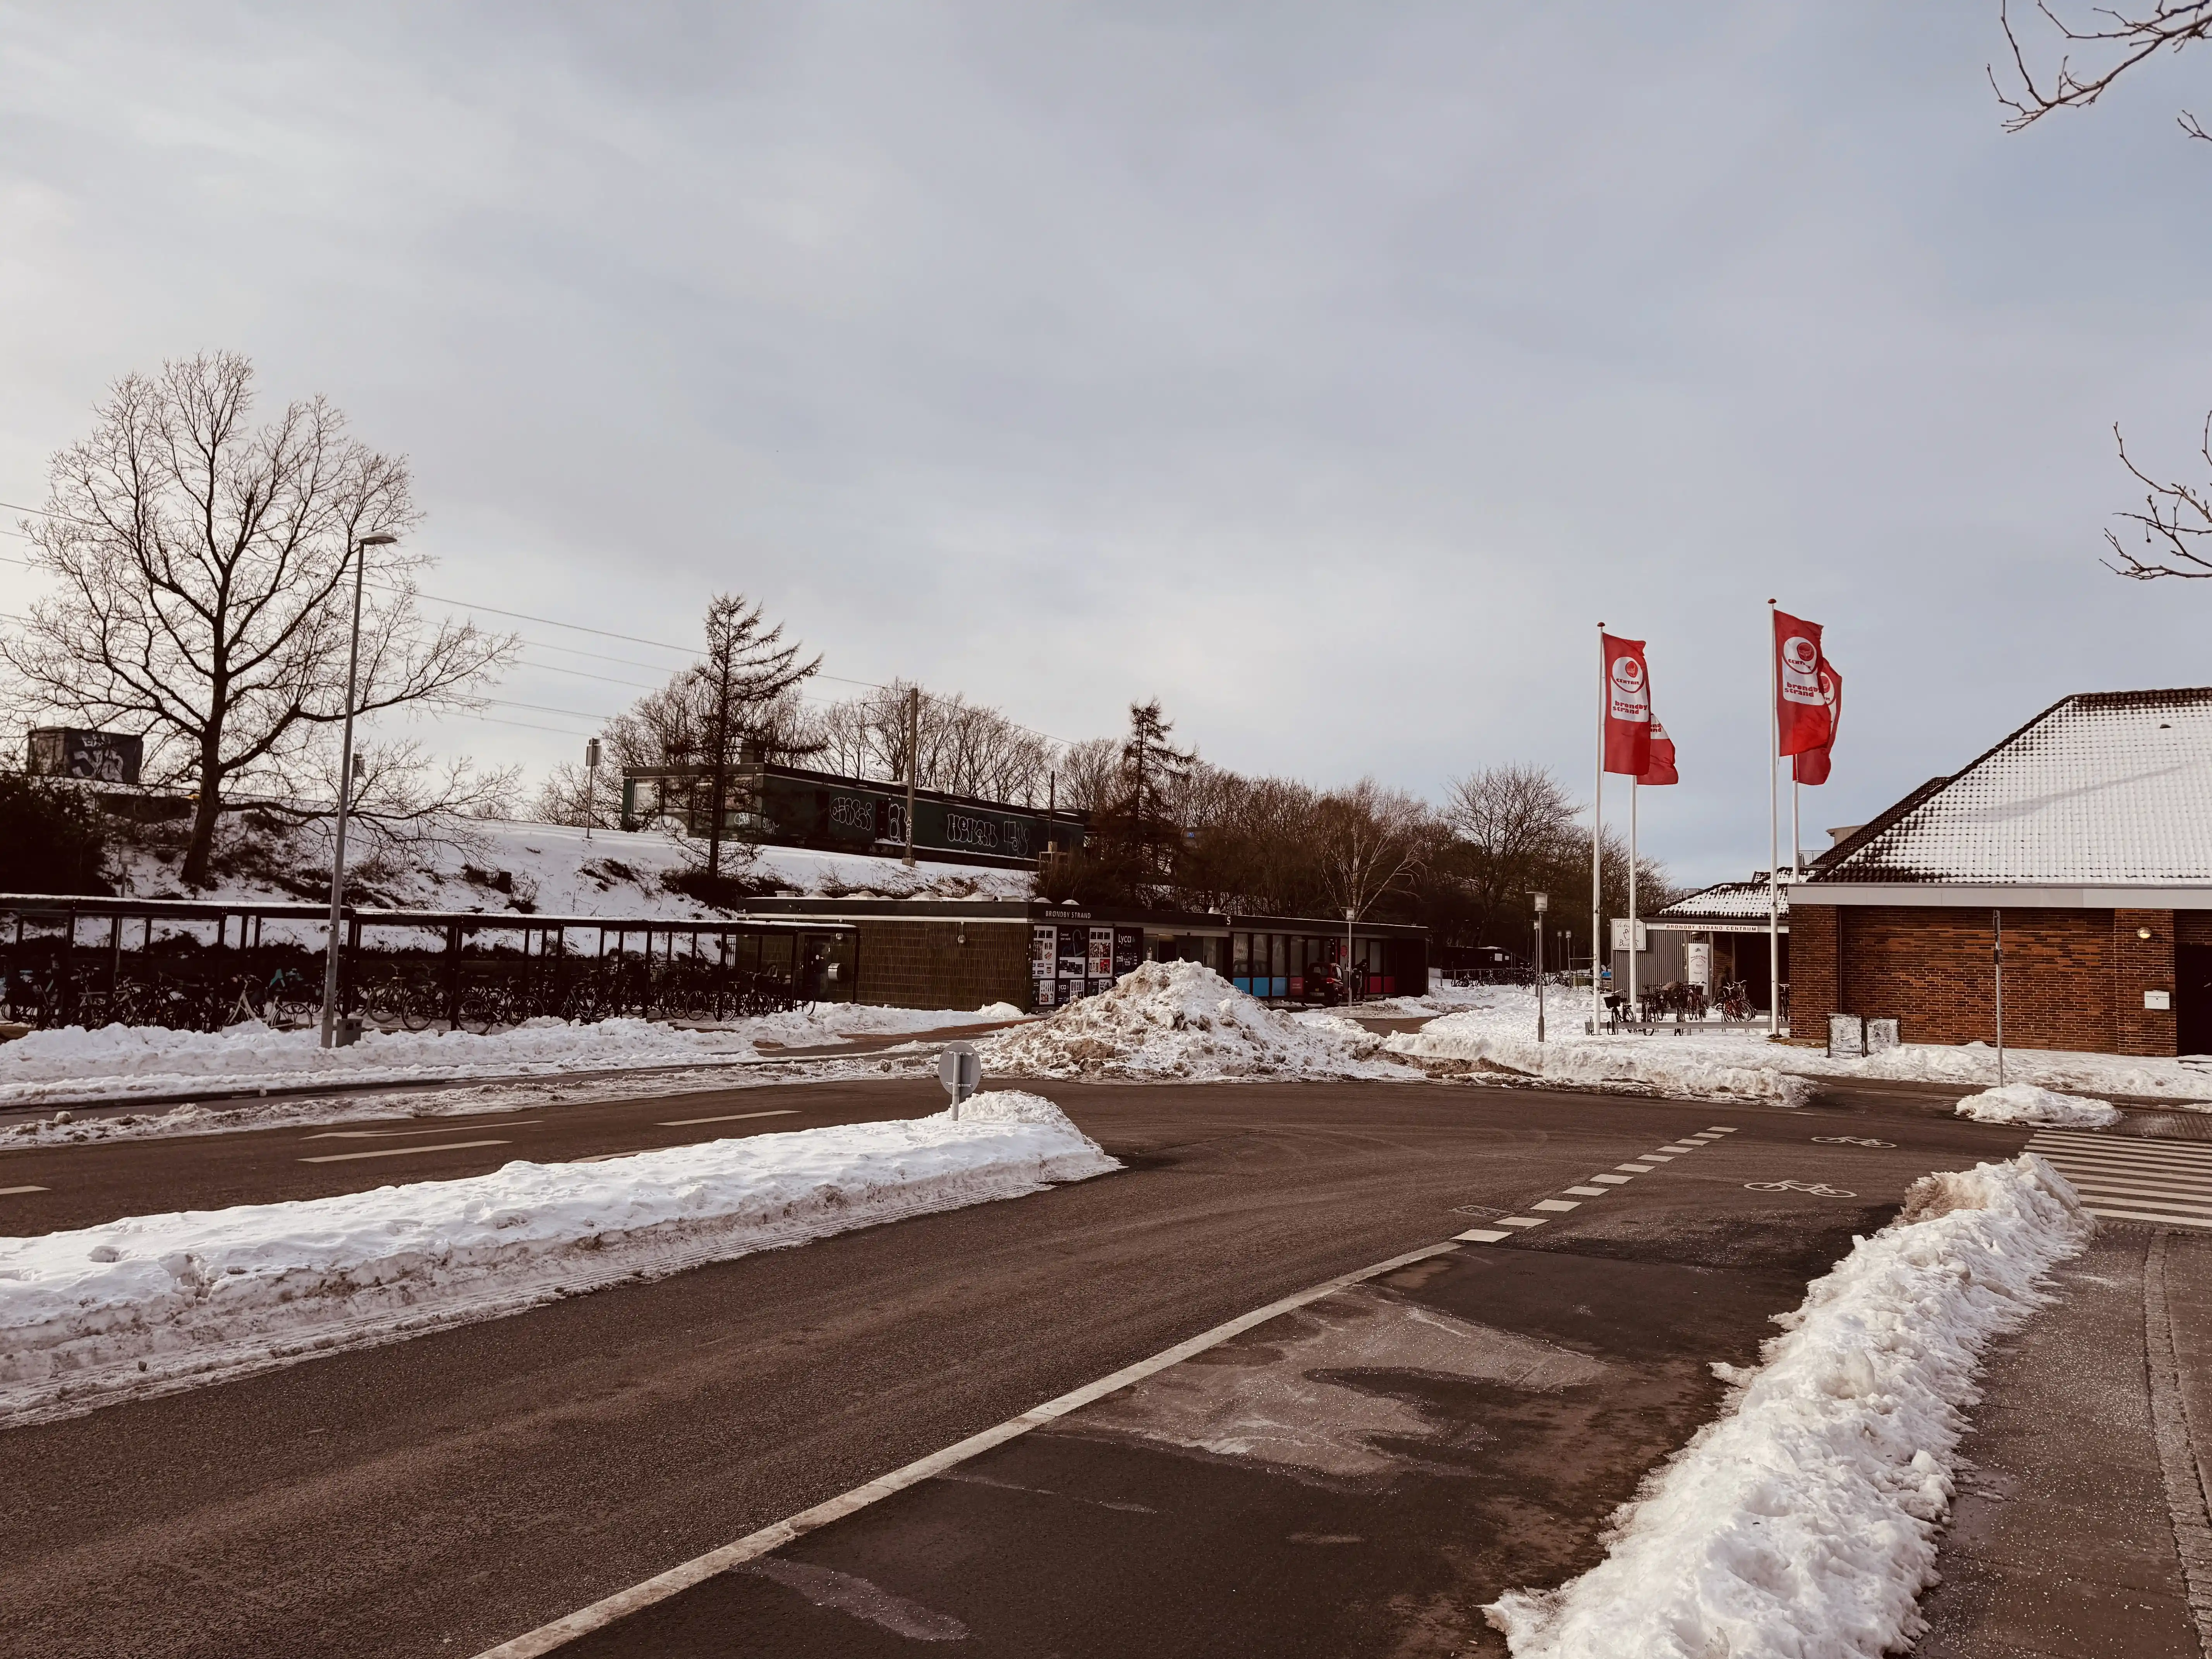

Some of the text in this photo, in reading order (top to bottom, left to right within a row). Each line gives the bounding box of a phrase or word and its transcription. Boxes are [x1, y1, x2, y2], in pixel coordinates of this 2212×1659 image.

[1784, 688, 1814, 697] strand
[1613, 706, 1639, 714] strand
[1118, 934, 1132, 945] Lyca
